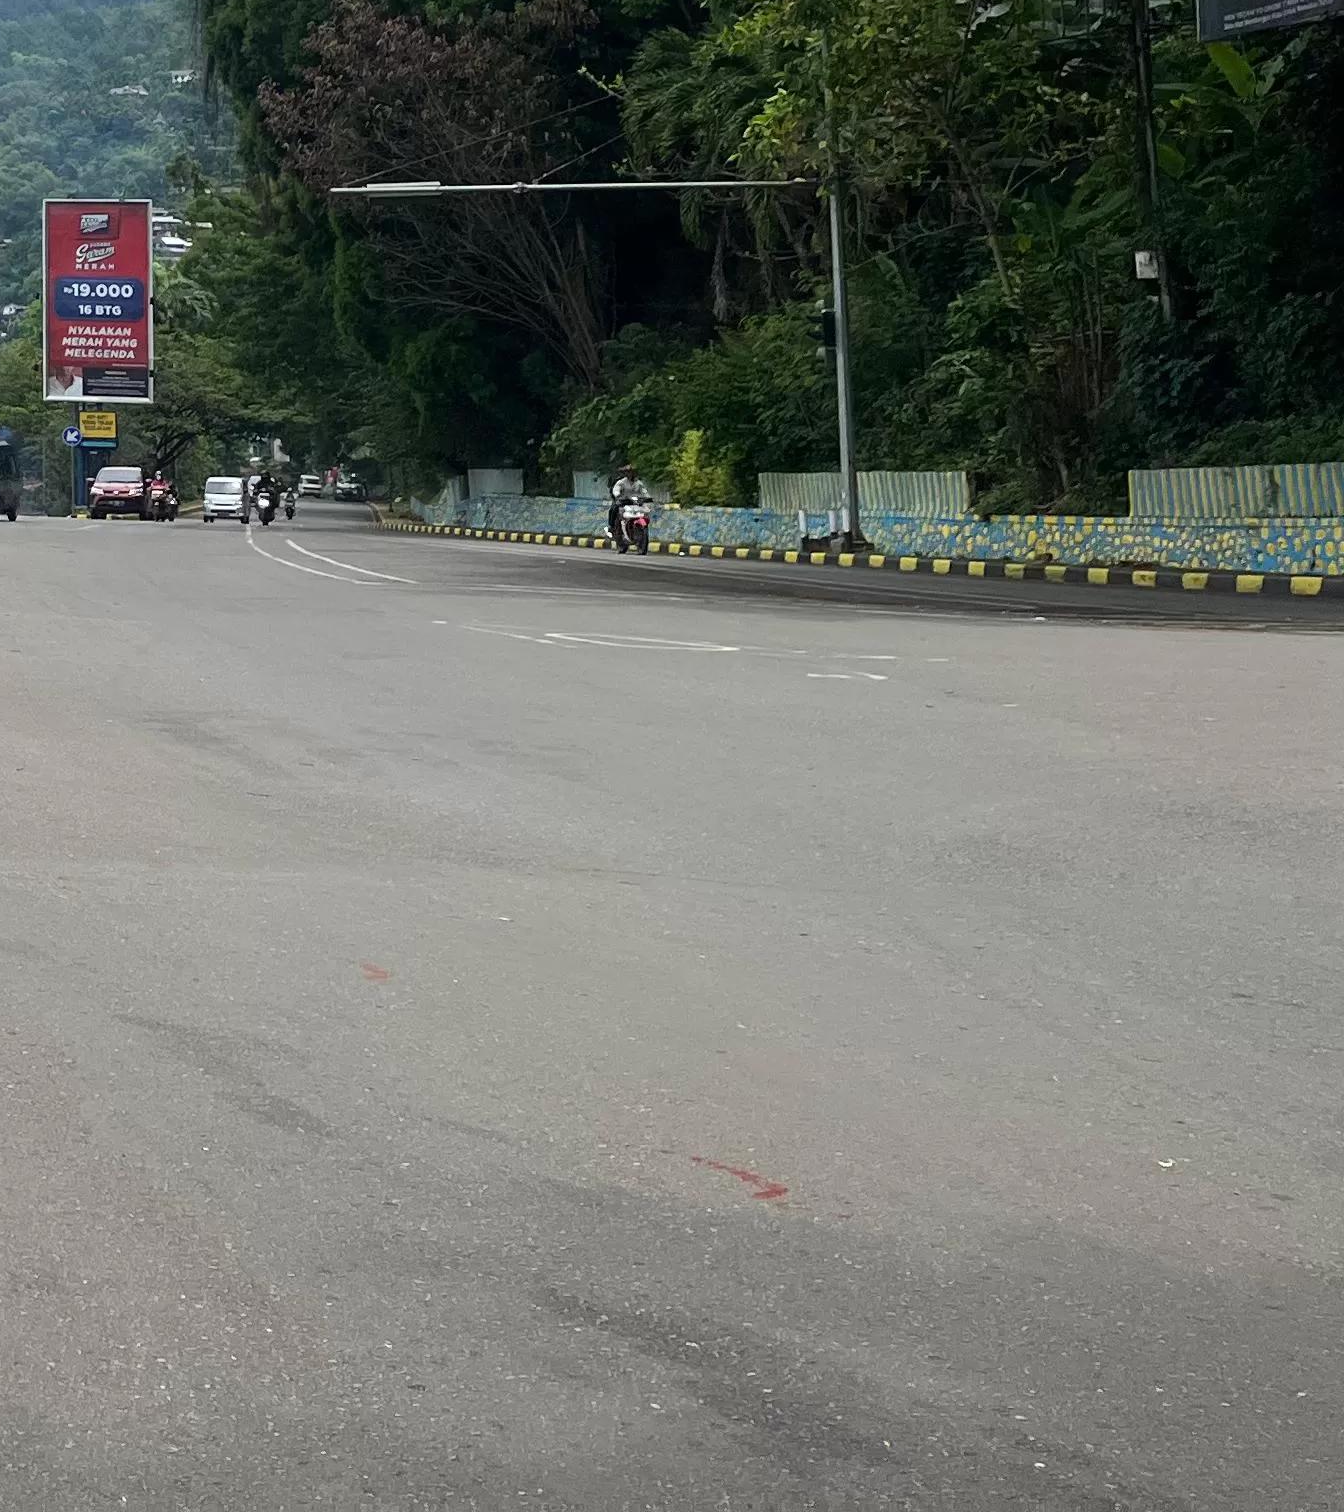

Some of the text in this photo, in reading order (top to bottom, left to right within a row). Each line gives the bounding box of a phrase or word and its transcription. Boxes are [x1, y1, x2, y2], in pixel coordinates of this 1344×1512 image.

[76, 244, 115, 263] Garam
[78, 304, 122, 316] 16 BTG
[68, 326, 131, 336] NYALAKAN
[62, 337, 137, 348] MERAH YANG
[64, 348, 135, 359] MELEGENDA
